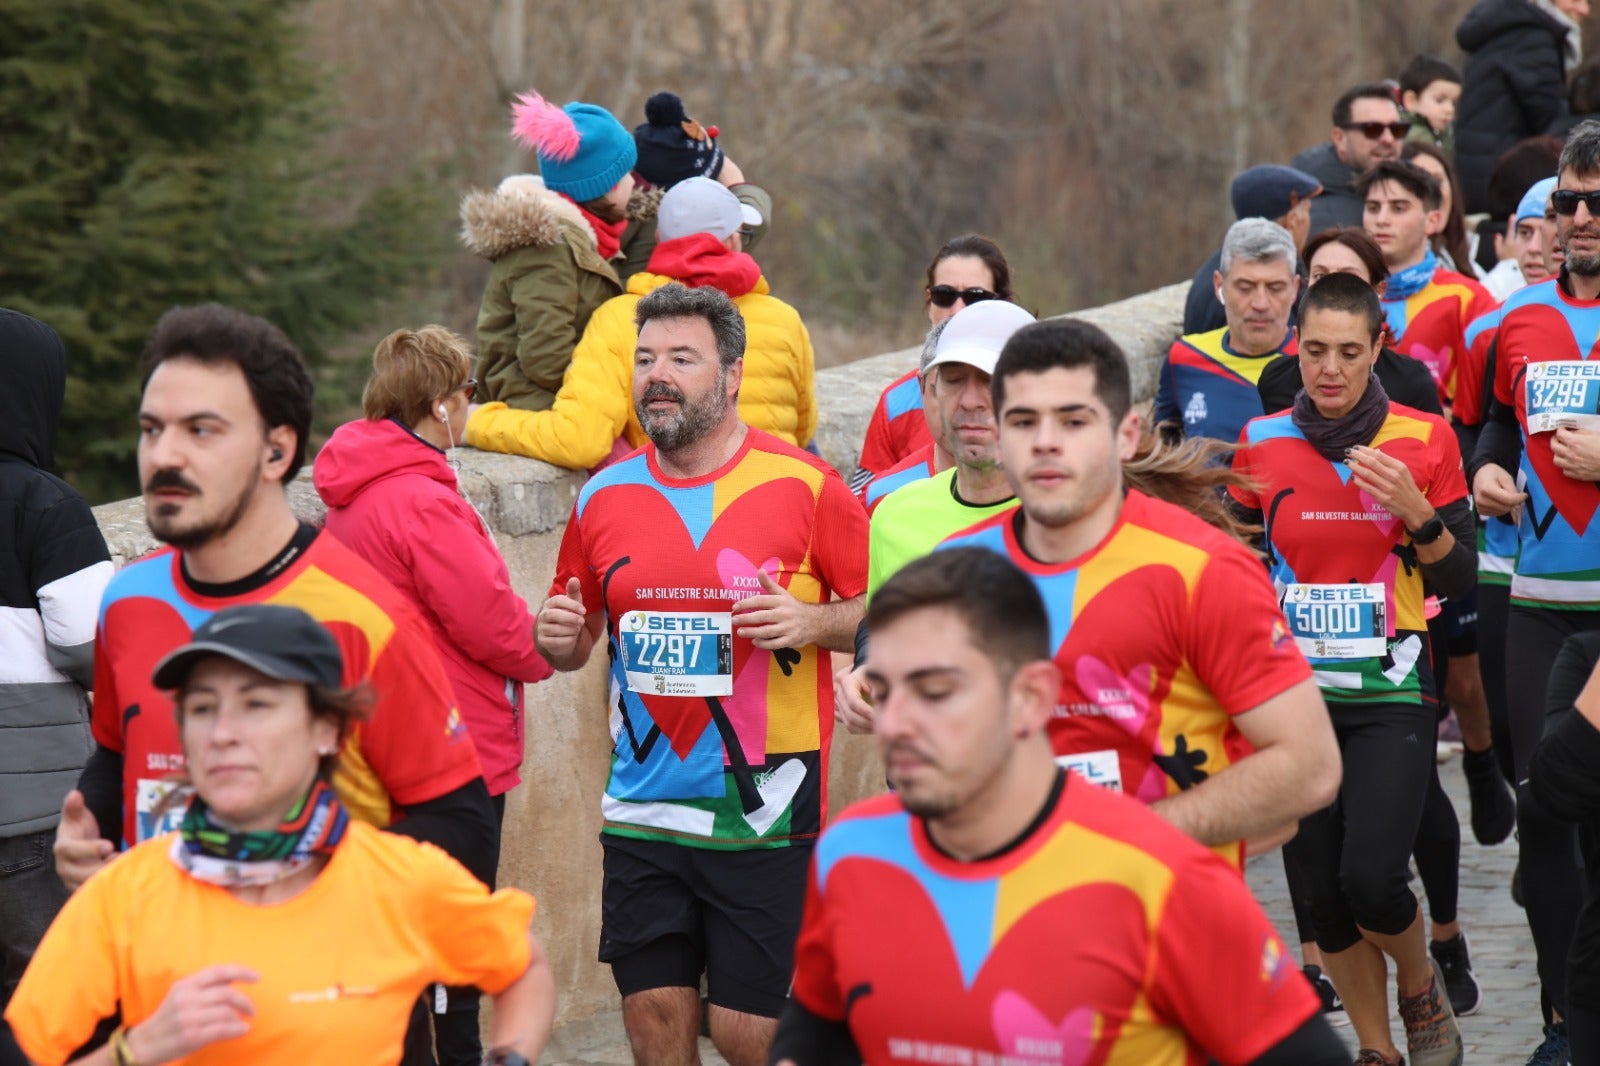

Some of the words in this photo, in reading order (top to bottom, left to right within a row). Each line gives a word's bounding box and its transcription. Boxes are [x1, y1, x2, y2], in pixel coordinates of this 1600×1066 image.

[1547, 365, 1600, 376] SETEL
[1532, 380, 1588, 408] 3299
[1301, 512, 1314, 520] SAN
[1316, 512, 1349, 520] SILVESTRE
[1350, 512, 1392, 520] SALMANTINA
[733, 576, 763, 588] XXXIX
[635, 588, 653, 599] SAN
[656, 588, 700, 600] SILVESTRE
[1310, 588, 1374, 600] SETEL
[648, 616, 719, 631] SETEL
[1295, 603, 1360, 632] 5000
[635, 633, 702, 668] 2297
[651, 667, 686, 675] JUANFRAN
